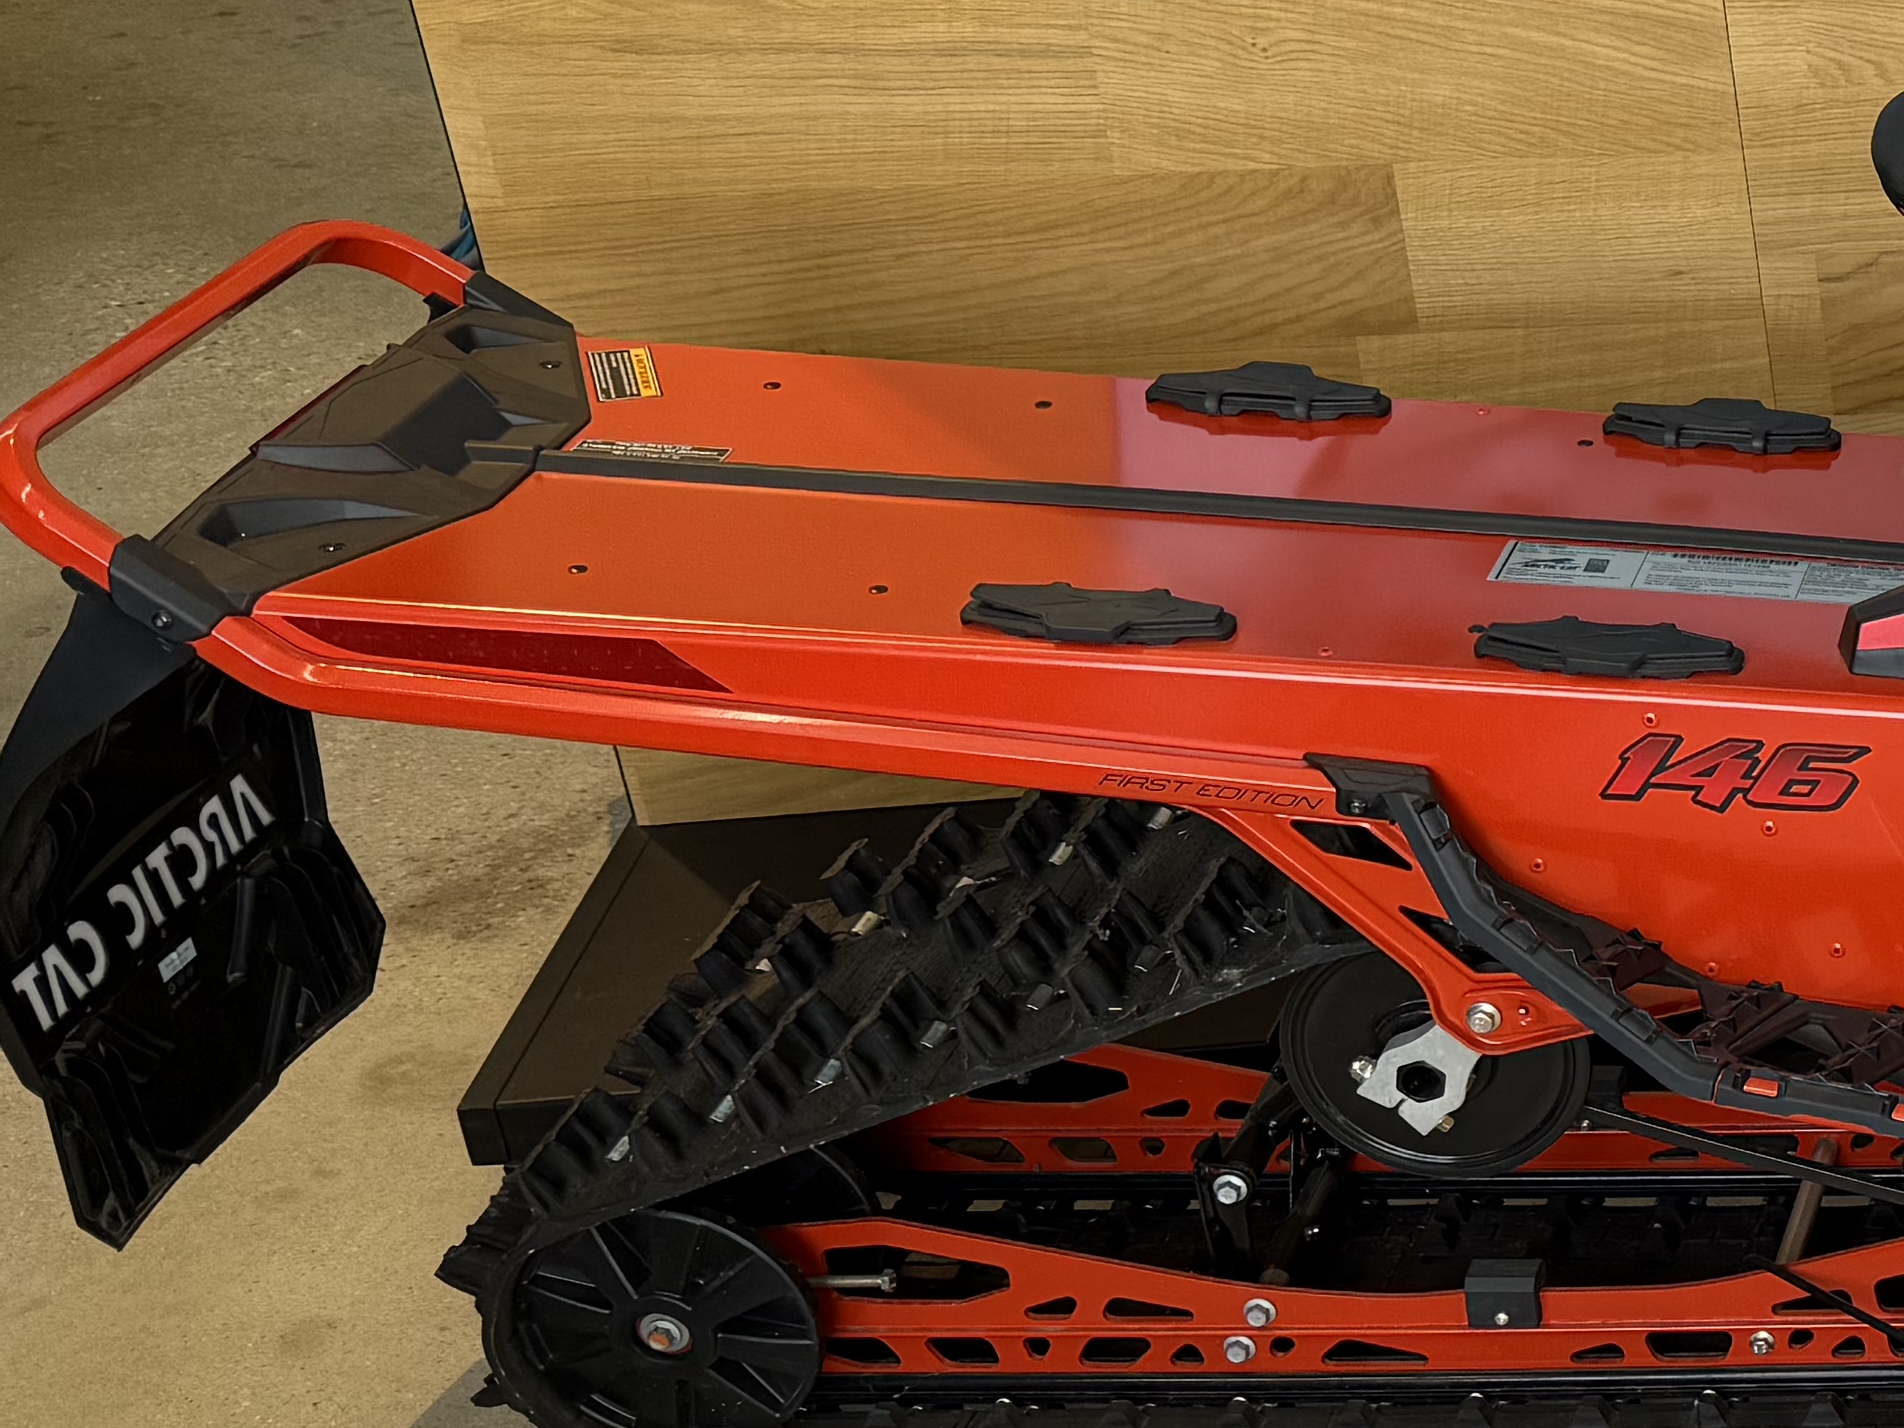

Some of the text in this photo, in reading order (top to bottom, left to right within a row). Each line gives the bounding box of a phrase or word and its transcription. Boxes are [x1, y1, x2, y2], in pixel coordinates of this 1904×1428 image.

[1099, 773, 1324, 810] FIRST EDITION
[1599, 732, 1872, 814] 146
